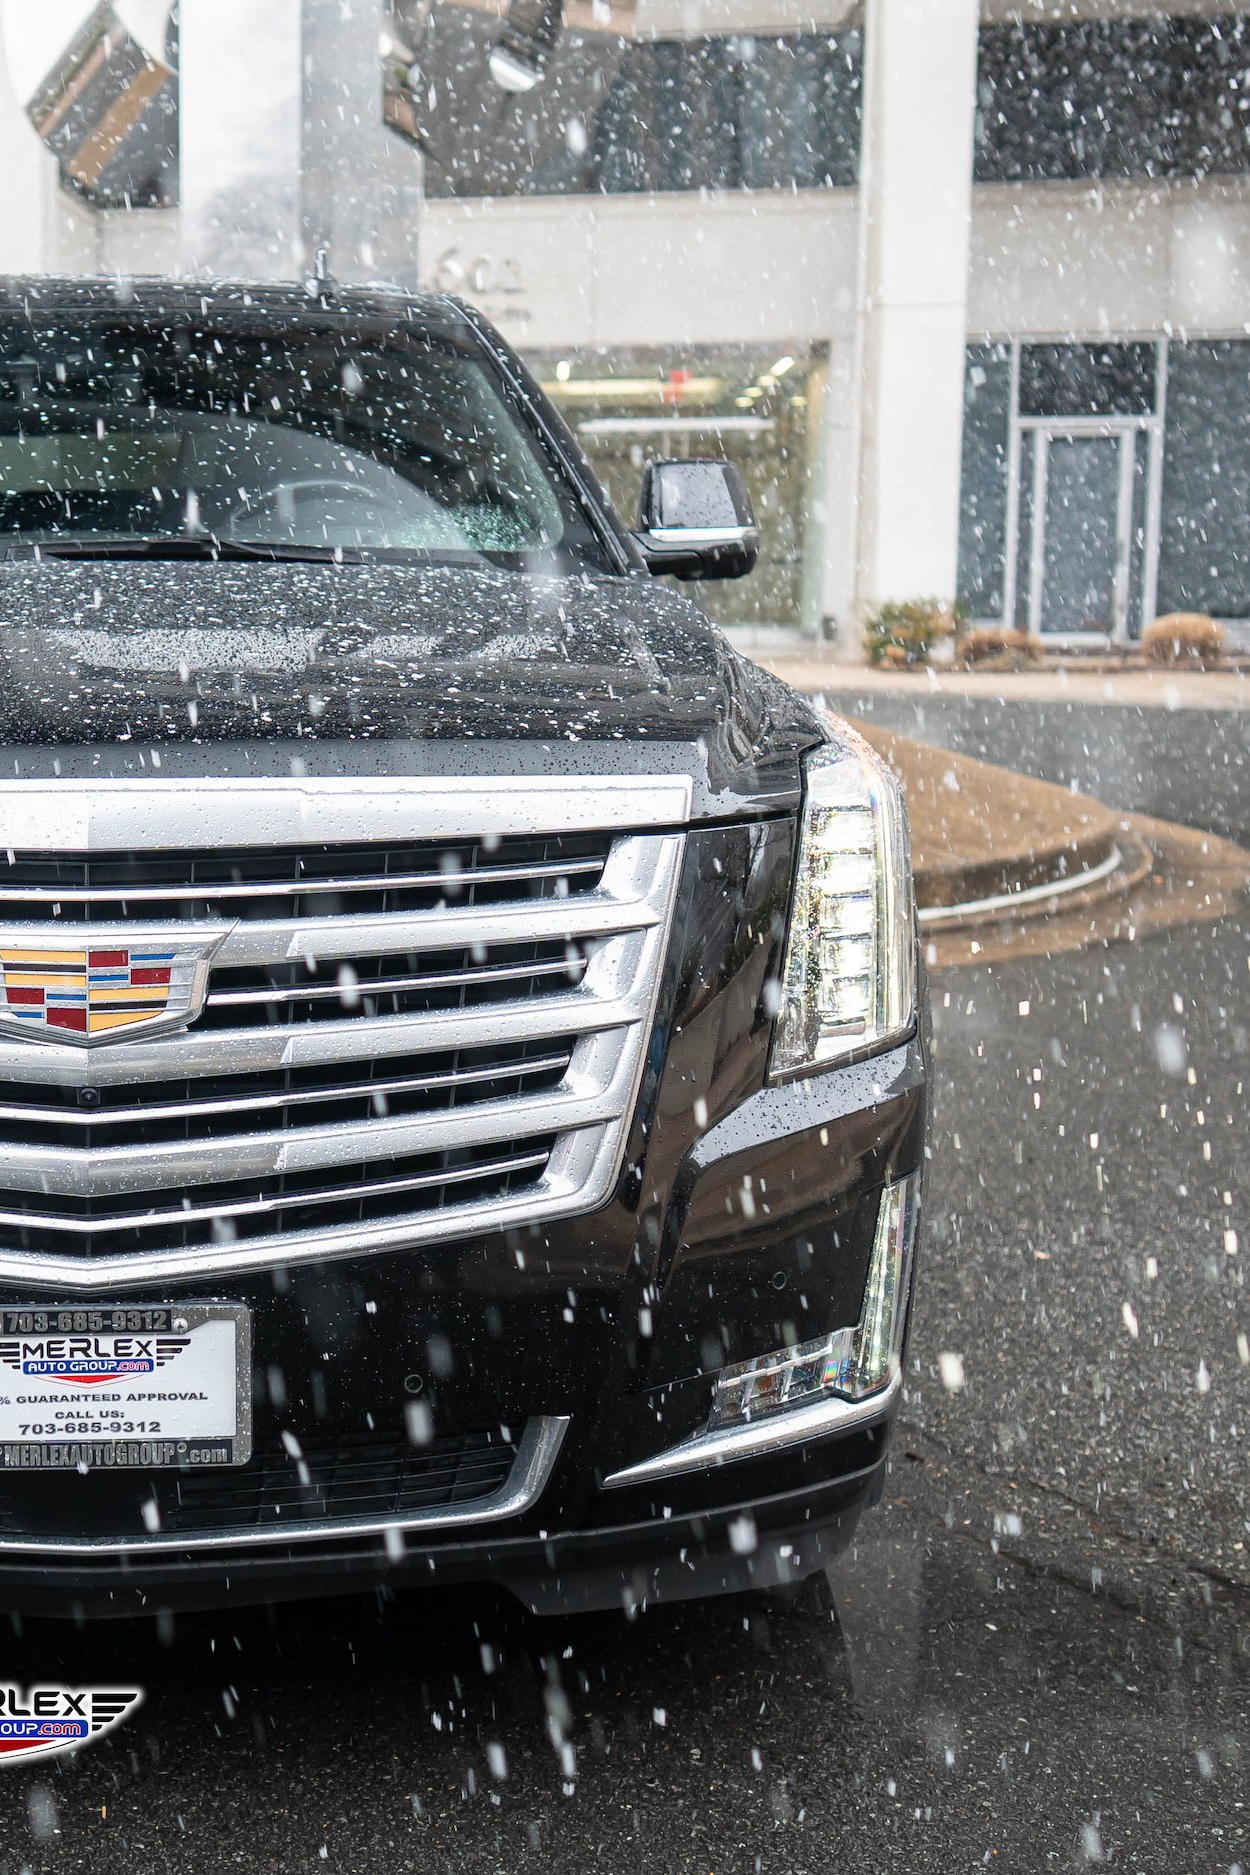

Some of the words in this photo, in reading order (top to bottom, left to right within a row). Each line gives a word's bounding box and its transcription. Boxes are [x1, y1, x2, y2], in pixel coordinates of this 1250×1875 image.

[6, 1310, 167, 1333] 703-685-9312
[22, 1338, 153, 1359] MERLEX
[28, 1362, 66, 1373] AUTO
[70, 1359, 151, 1372] GROUP.com
[16, 1393, 122, 1405] GUARANTEED
[126, 1392, 208, 1402] APPROVAL
[54, 1411, 94, 1420] CALL
[100, 1410, 126, 1419] US:
[19, 1421, 162, 1436] 703-685-9312
